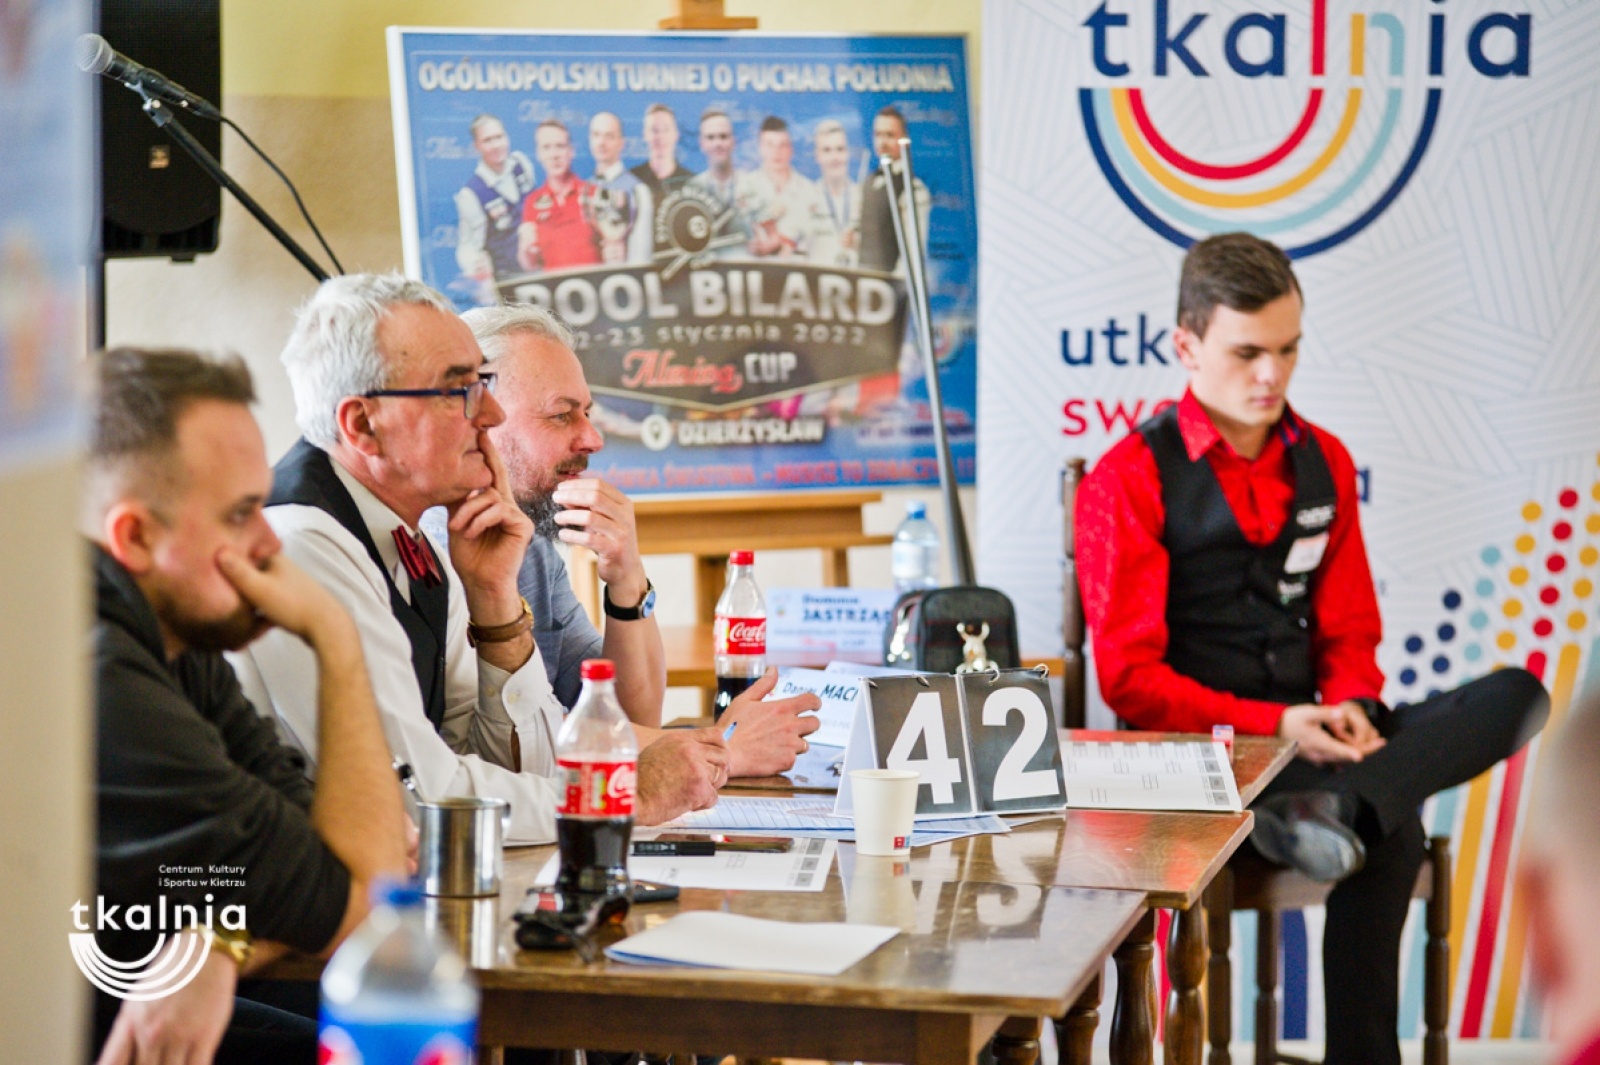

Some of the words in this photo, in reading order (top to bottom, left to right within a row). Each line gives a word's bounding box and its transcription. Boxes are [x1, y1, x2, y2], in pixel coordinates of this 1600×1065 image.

[1081, 0, 1532, 78] tkalnia
[418, 56, 609, 92] OGÓLNOPOLSKI
[612, 63, 710, 92] TURNIEJ
[713, 64, 732, 92] O
[737, 63, 833, 92] PUCHAR
[691, 270, 895, 326] BILARD
[657, 320, 781, 345] stycznia
[794, 322, 866, 345] 2022
[1061, 313, 1171, 367] utk
[744, 352, 797, 383] CUP
